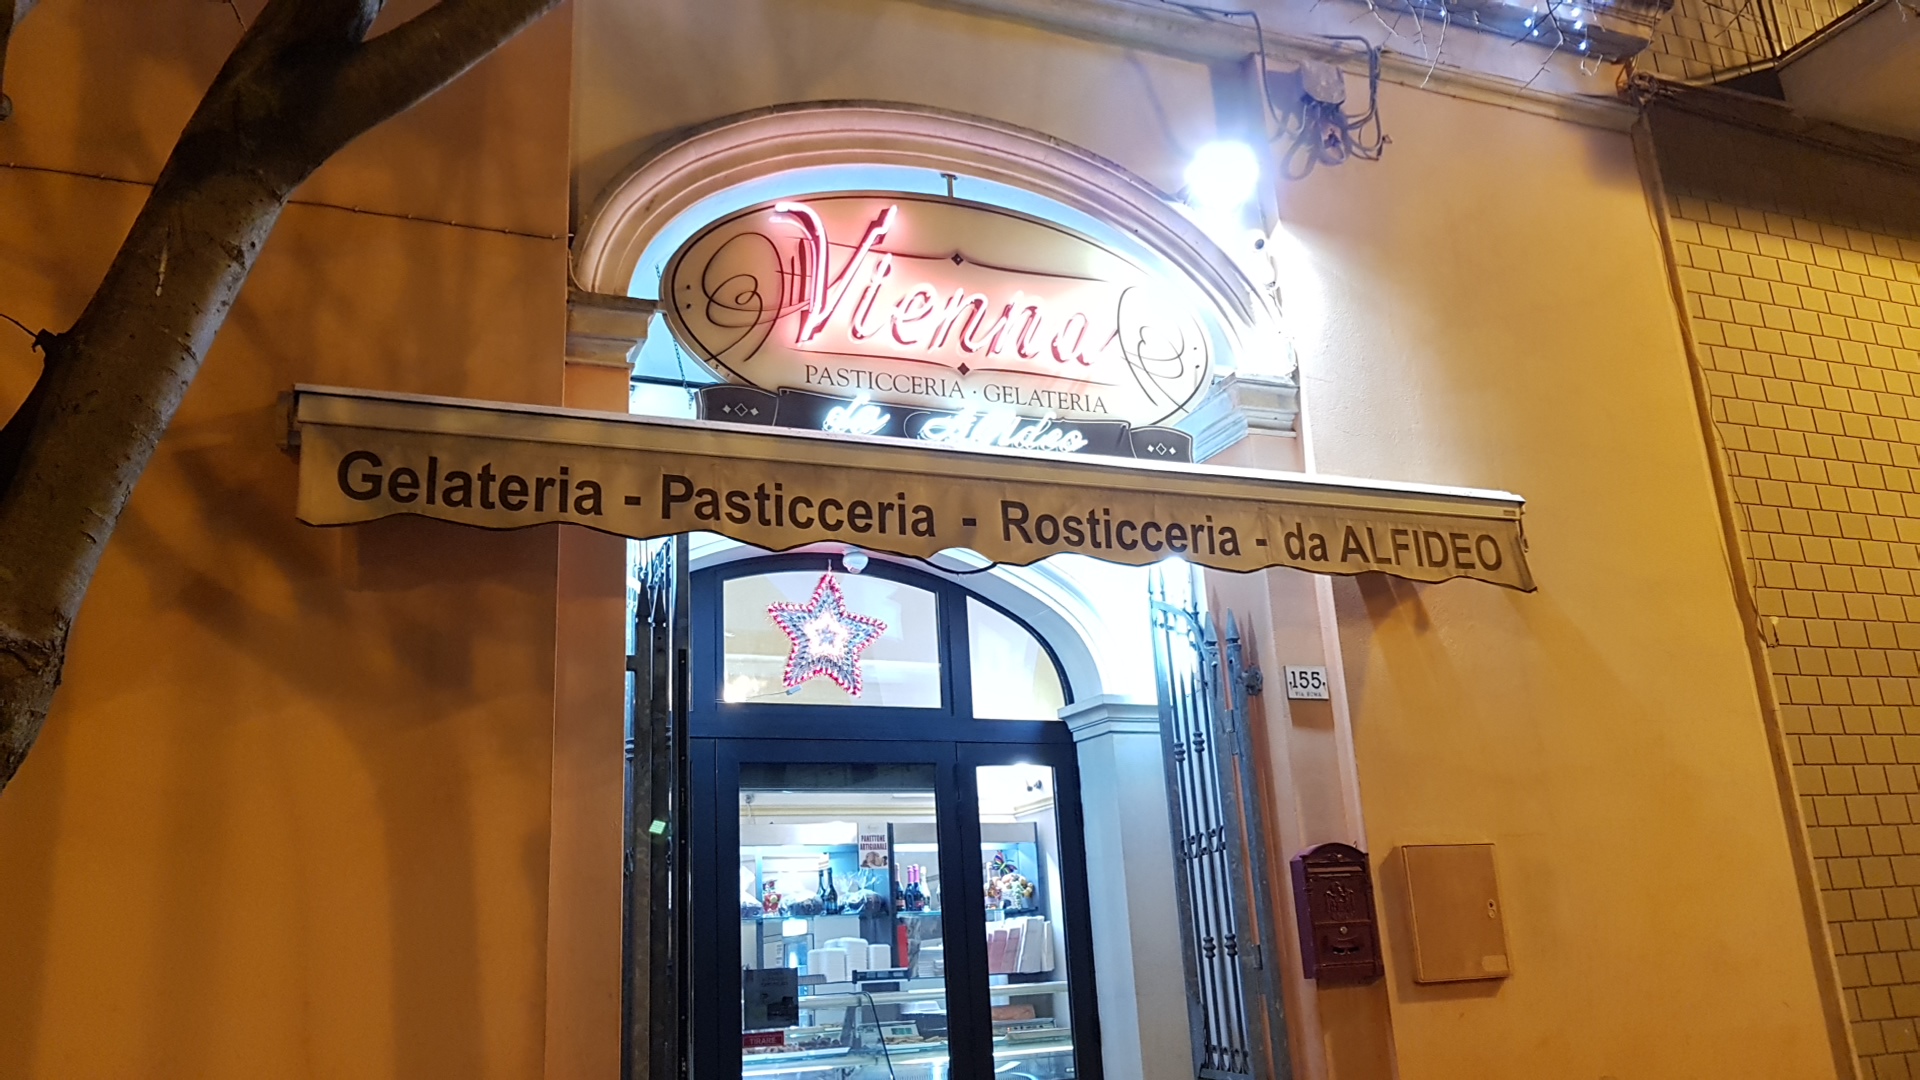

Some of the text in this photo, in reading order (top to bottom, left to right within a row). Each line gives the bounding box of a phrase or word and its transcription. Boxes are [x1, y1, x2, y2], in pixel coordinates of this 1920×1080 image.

[769, 201, 1106, 367] Vienna
[804, 364, 1109, 415] PASTICCERIA GELATERIA
[822, 392, 891, 434] da
[337, 450, 604, 516] Gelateria
[661, 473, 936, 538] Pasticceria
[1001, 499, 1242, 557] Rosticceria
[1284, 523, 1330, 562] da
[1340, 524, 1503, 571] ALFIDEO
[1291, 671, 1321, 689] 155
[750, 1036, 776, 1045] TIRARE
